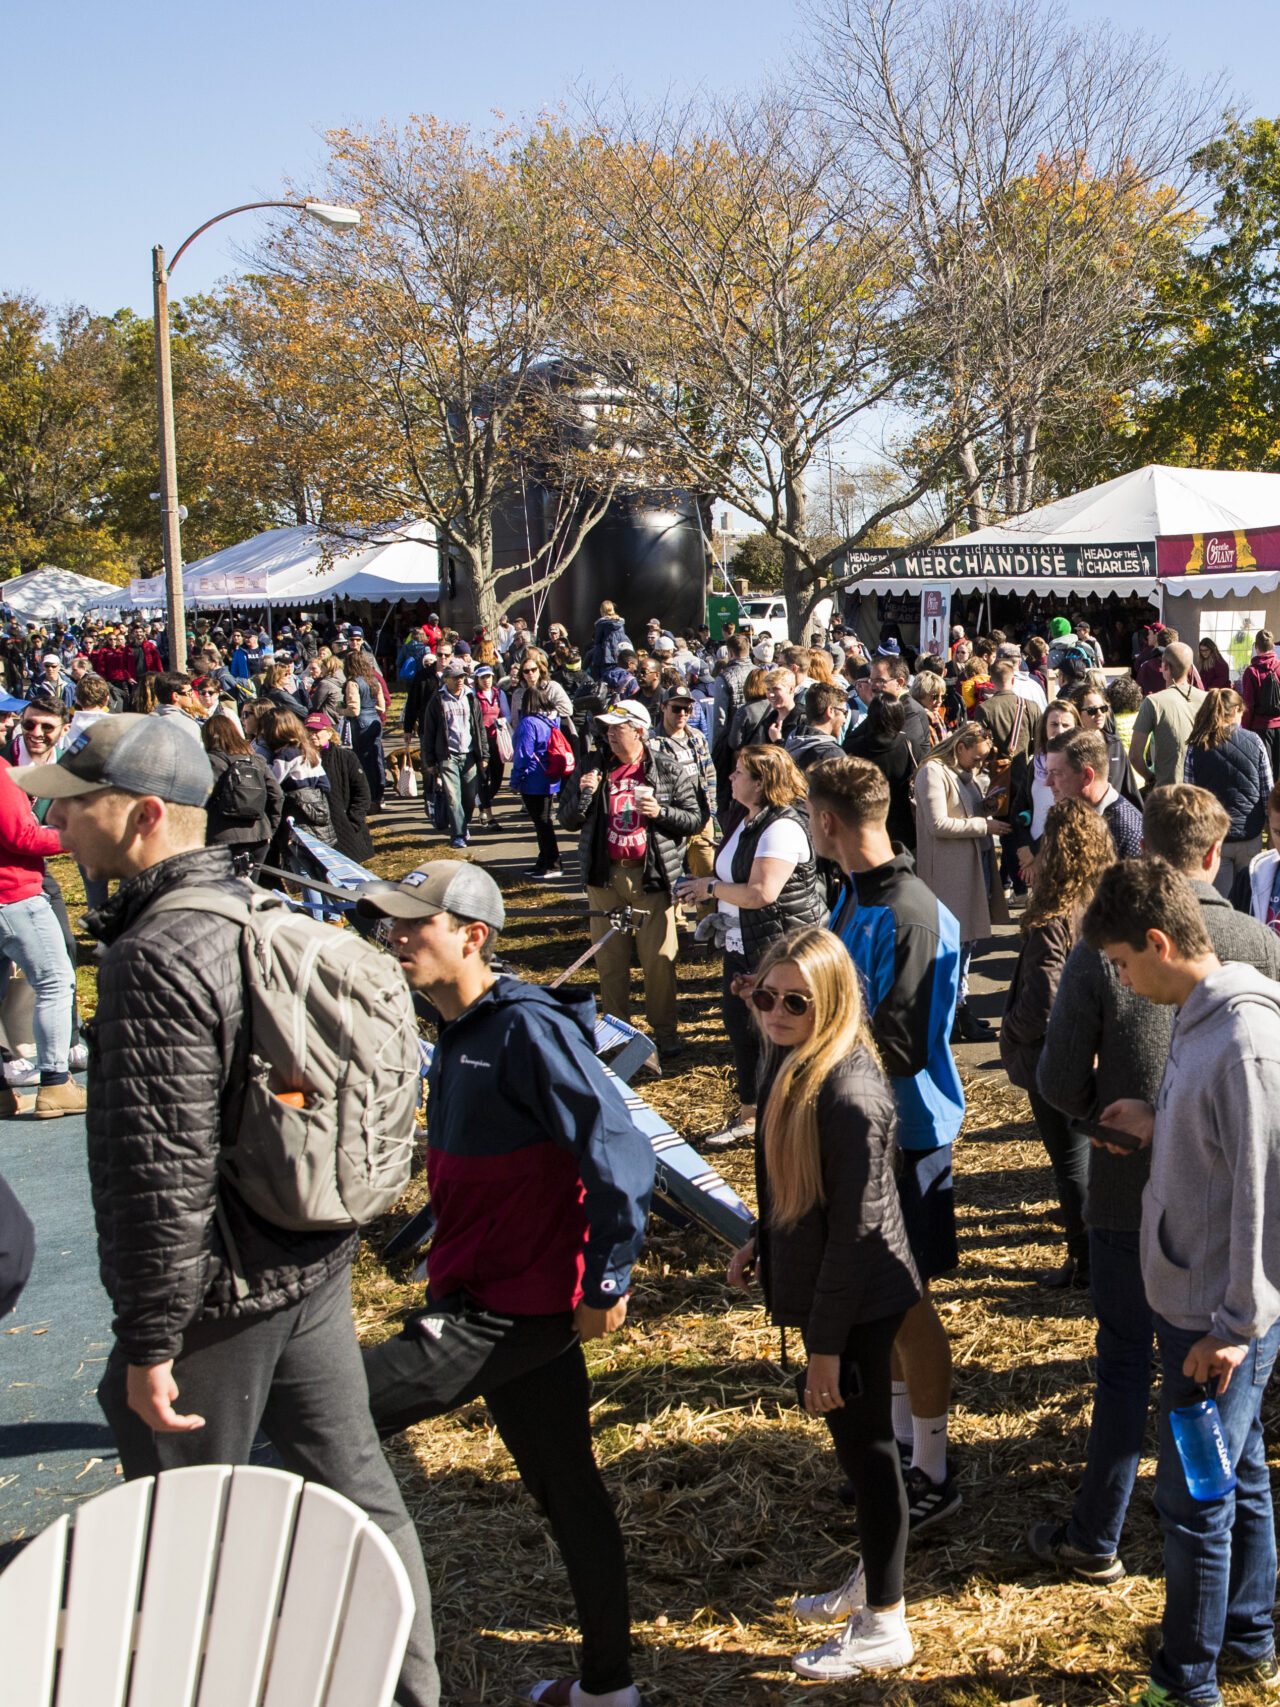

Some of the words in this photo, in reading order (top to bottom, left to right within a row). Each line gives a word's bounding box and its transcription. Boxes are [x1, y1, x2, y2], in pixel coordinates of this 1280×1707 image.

[850, 552, 870, 562] HEAD
[907, 547, 960, 557] FFICIALLY
[965, 546, 1014, 555] LICENSED
[1020, 546, 1064, 554] REGATTA
[1084, 548, 1112, 560] HEAD
[1113, 551, 1123, 559] OF
[1123, 550, 1138, 558] THE
[904, 554, 1068, 576] MERCHANDISE
[1086, 560, 1140, 574] CHARLES
